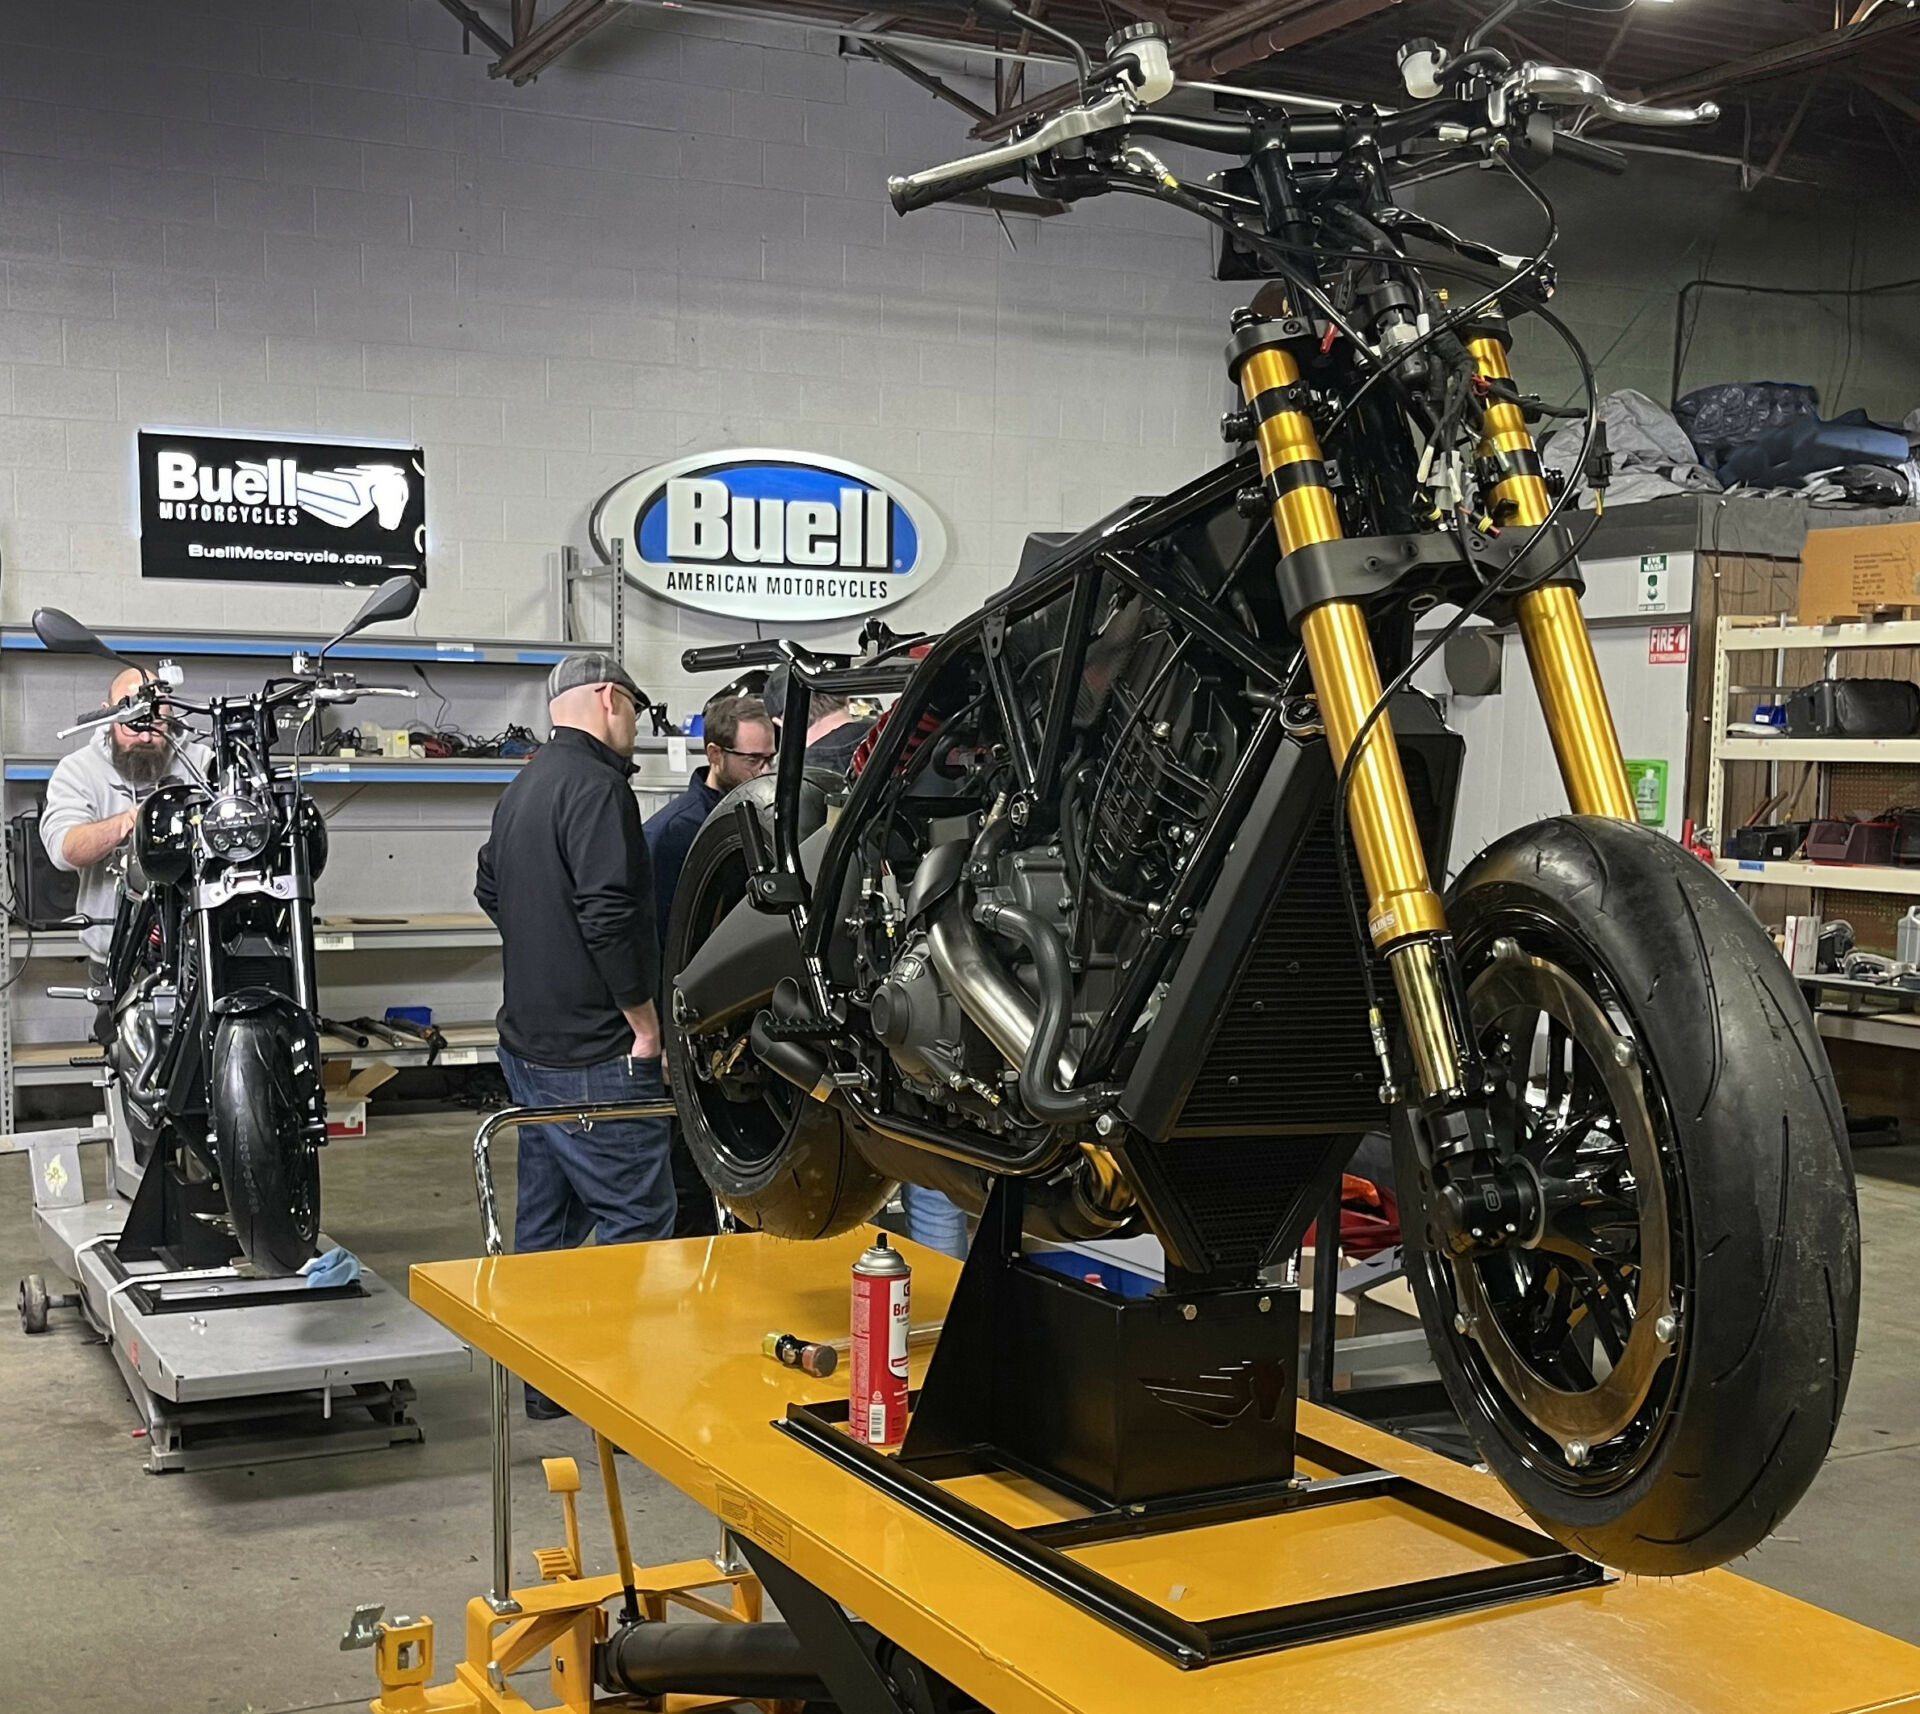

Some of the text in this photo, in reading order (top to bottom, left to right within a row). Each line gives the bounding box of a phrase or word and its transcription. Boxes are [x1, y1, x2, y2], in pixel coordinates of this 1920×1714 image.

[157, 451, 298, 507] Buell
[158, 501, 299, 526] MOTORCYCLES
[666, 478, 889, 569] Buell
[187, 543, 383, 565] BuellMotorcycle.com
[666, 571, 889, 599] AMERICAN MOTORCYCLES
[1650, 627, 1675, 652] FIRE
